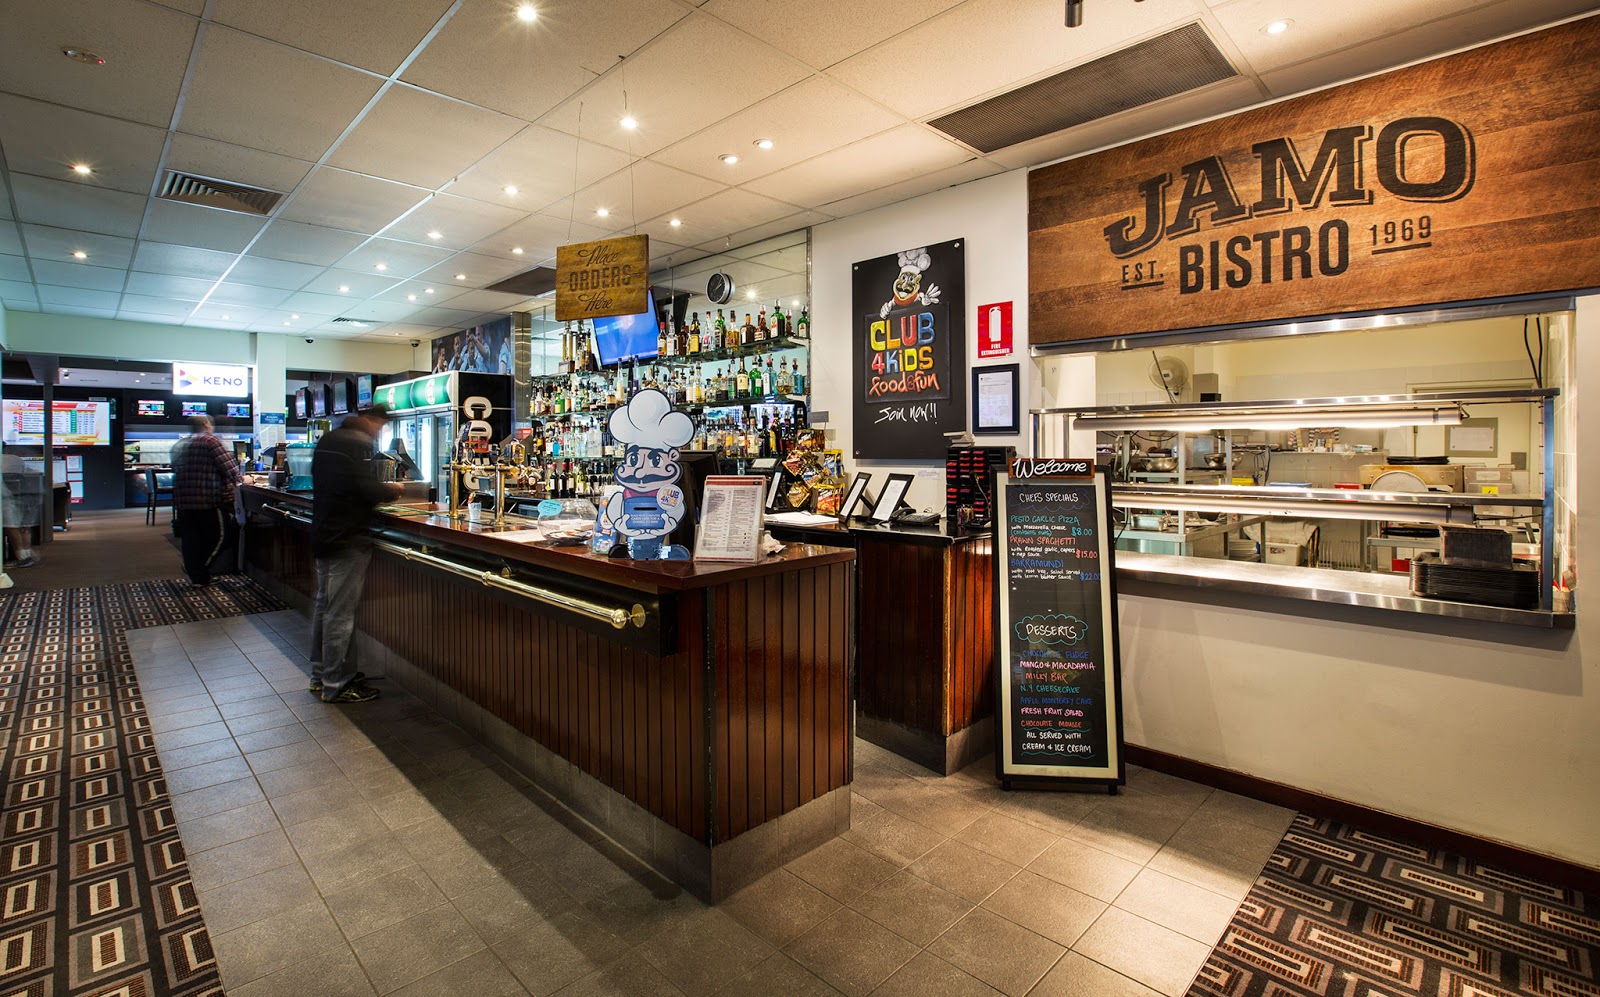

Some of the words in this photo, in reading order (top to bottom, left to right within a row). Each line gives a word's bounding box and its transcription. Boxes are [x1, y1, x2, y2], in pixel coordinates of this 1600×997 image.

[1103, 116, 1476, 259] JAMO
[577, 245, 620, 267] Place
[1120, 259, 1163, 284] EST.
[1179, 218, 1350, 295] BISTRO
[1368, 214, 1432, 247] 1969
[569, 264, 631, 292] ORDERS
[578, 290, 613, 311] Here
[870, 311, 935, 352] CLUB
[203, 376, 243, 386] KENO
[1012, 458, 1087, 478] Welcome
[1019, 492, 1043, 502] CHEFS
[1045, 492, 1079, 502] SPECIALS
[1010, 515, 1030, 523] PESTO
[1058, 515, 1080, 526] PIZZA
[1071, 526, 1093, 537] $8.00
[1010, 536, 1034, 546] PRAWN
[1036, 537, 1076, 546] SPAGHETTI
[1076, 548, 1098, 558] $15.00
[1011, 560, 1064, 570] BARRAMUNDI
[1026, 624, 1077, 638] DESSERTS
[1066, 651, 1089, 659] FUDGE
[1020, 660, 1044, 668] MANGO
[1052, 661, 1096, 670] MACADAMIA
[1026, 672, 1048, 682] MILKY
[1050, 672, 1068, 684] BAR
[1036, 685, 1080, 694] CHEESECAKE
[1064, 709, 1084, 717] SALAD
[1021, 720, 1052, 728] CHOCOLATE
[1058, 720, 1082, 728] MOUSSE
[1040, 731, 1062, 740] SERVED
[1022, 742, 1046, 750] CREAM
[1054, 743, 1064, 751] ICE
[1066, 744, 1092, 754] CREAM
